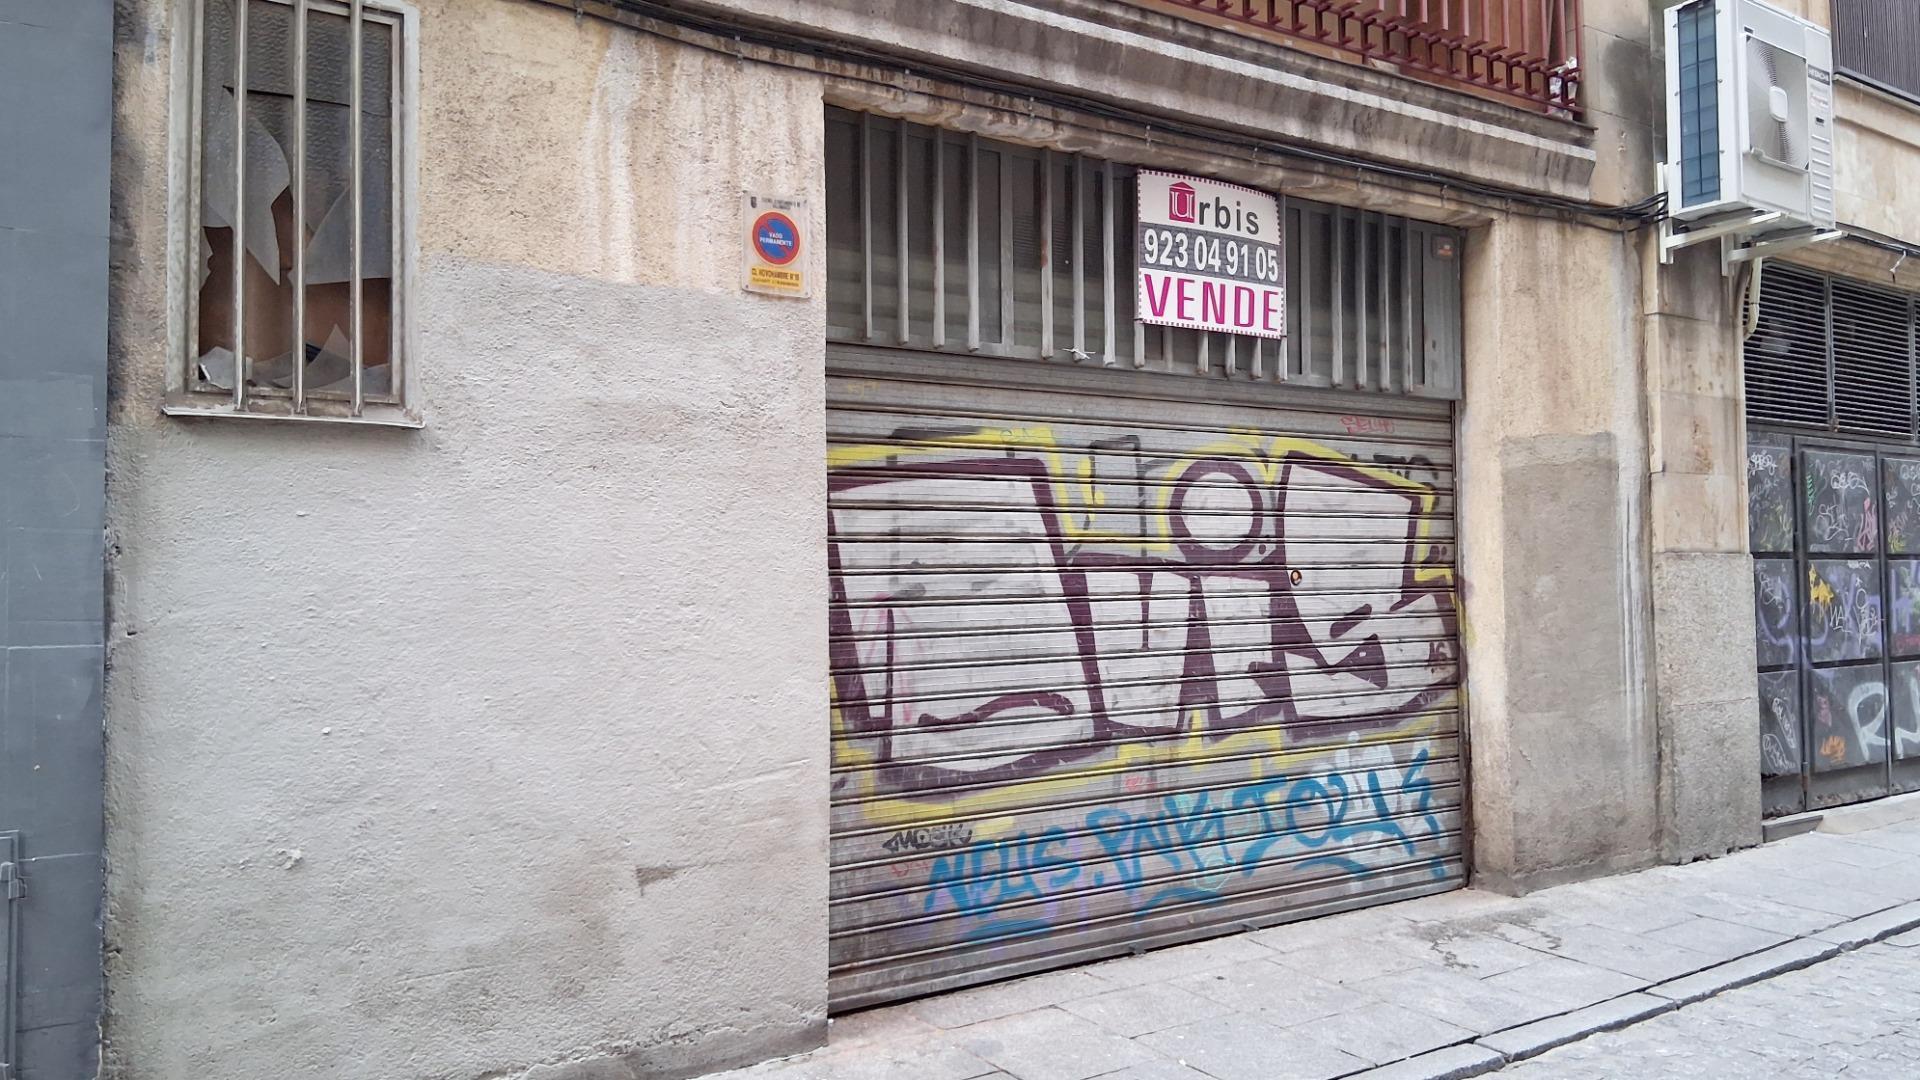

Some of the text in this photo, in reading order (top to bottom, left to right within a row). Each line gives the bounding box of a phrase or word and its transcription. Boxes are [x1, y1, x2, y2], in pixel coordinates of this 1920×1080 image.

[1170, 186, 1260, 235] Urbis
[1144, 228, 1279, 282] 923 04 91 05
[1144, 273, 1279, 332] VENDE
